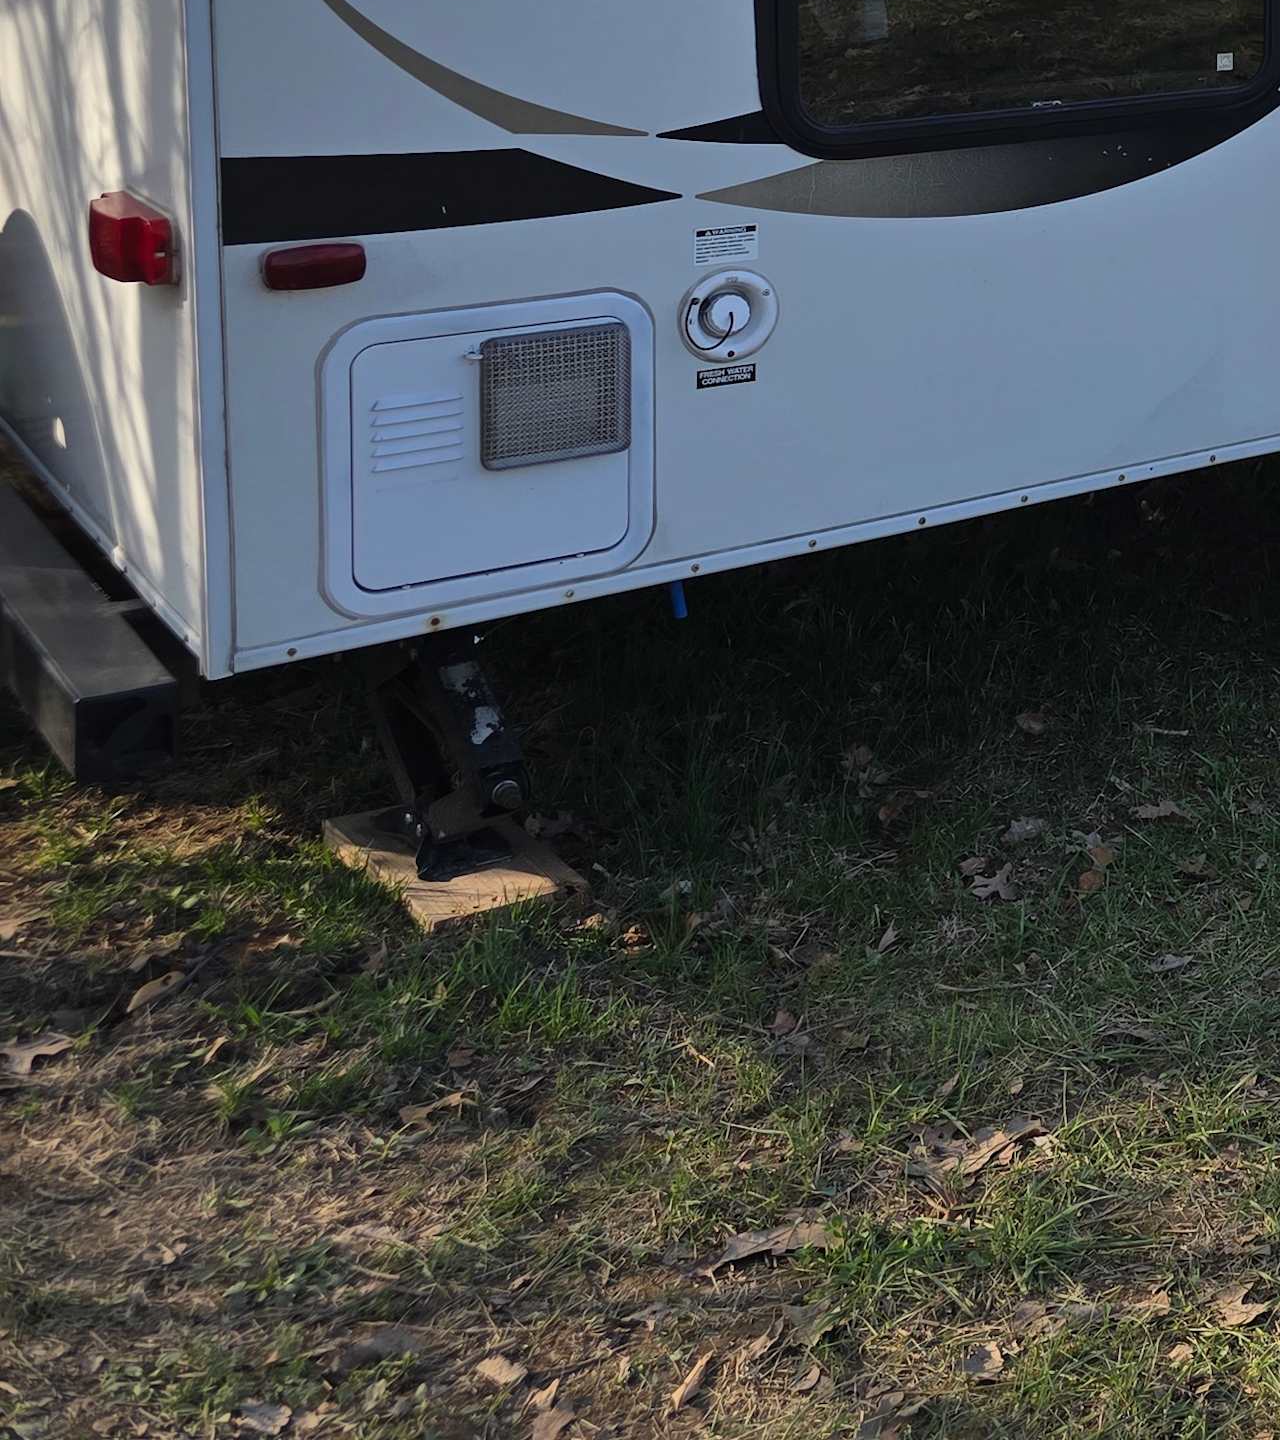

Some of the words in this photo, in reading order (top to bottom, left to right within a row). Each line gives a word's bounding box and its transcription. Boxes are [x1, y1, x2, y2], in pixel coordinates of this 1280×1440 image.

[700, 370, 726, 379] FRESH
[727, 365, 754, 375] WATER
[701, 373, 752, 385] CONNECTION
